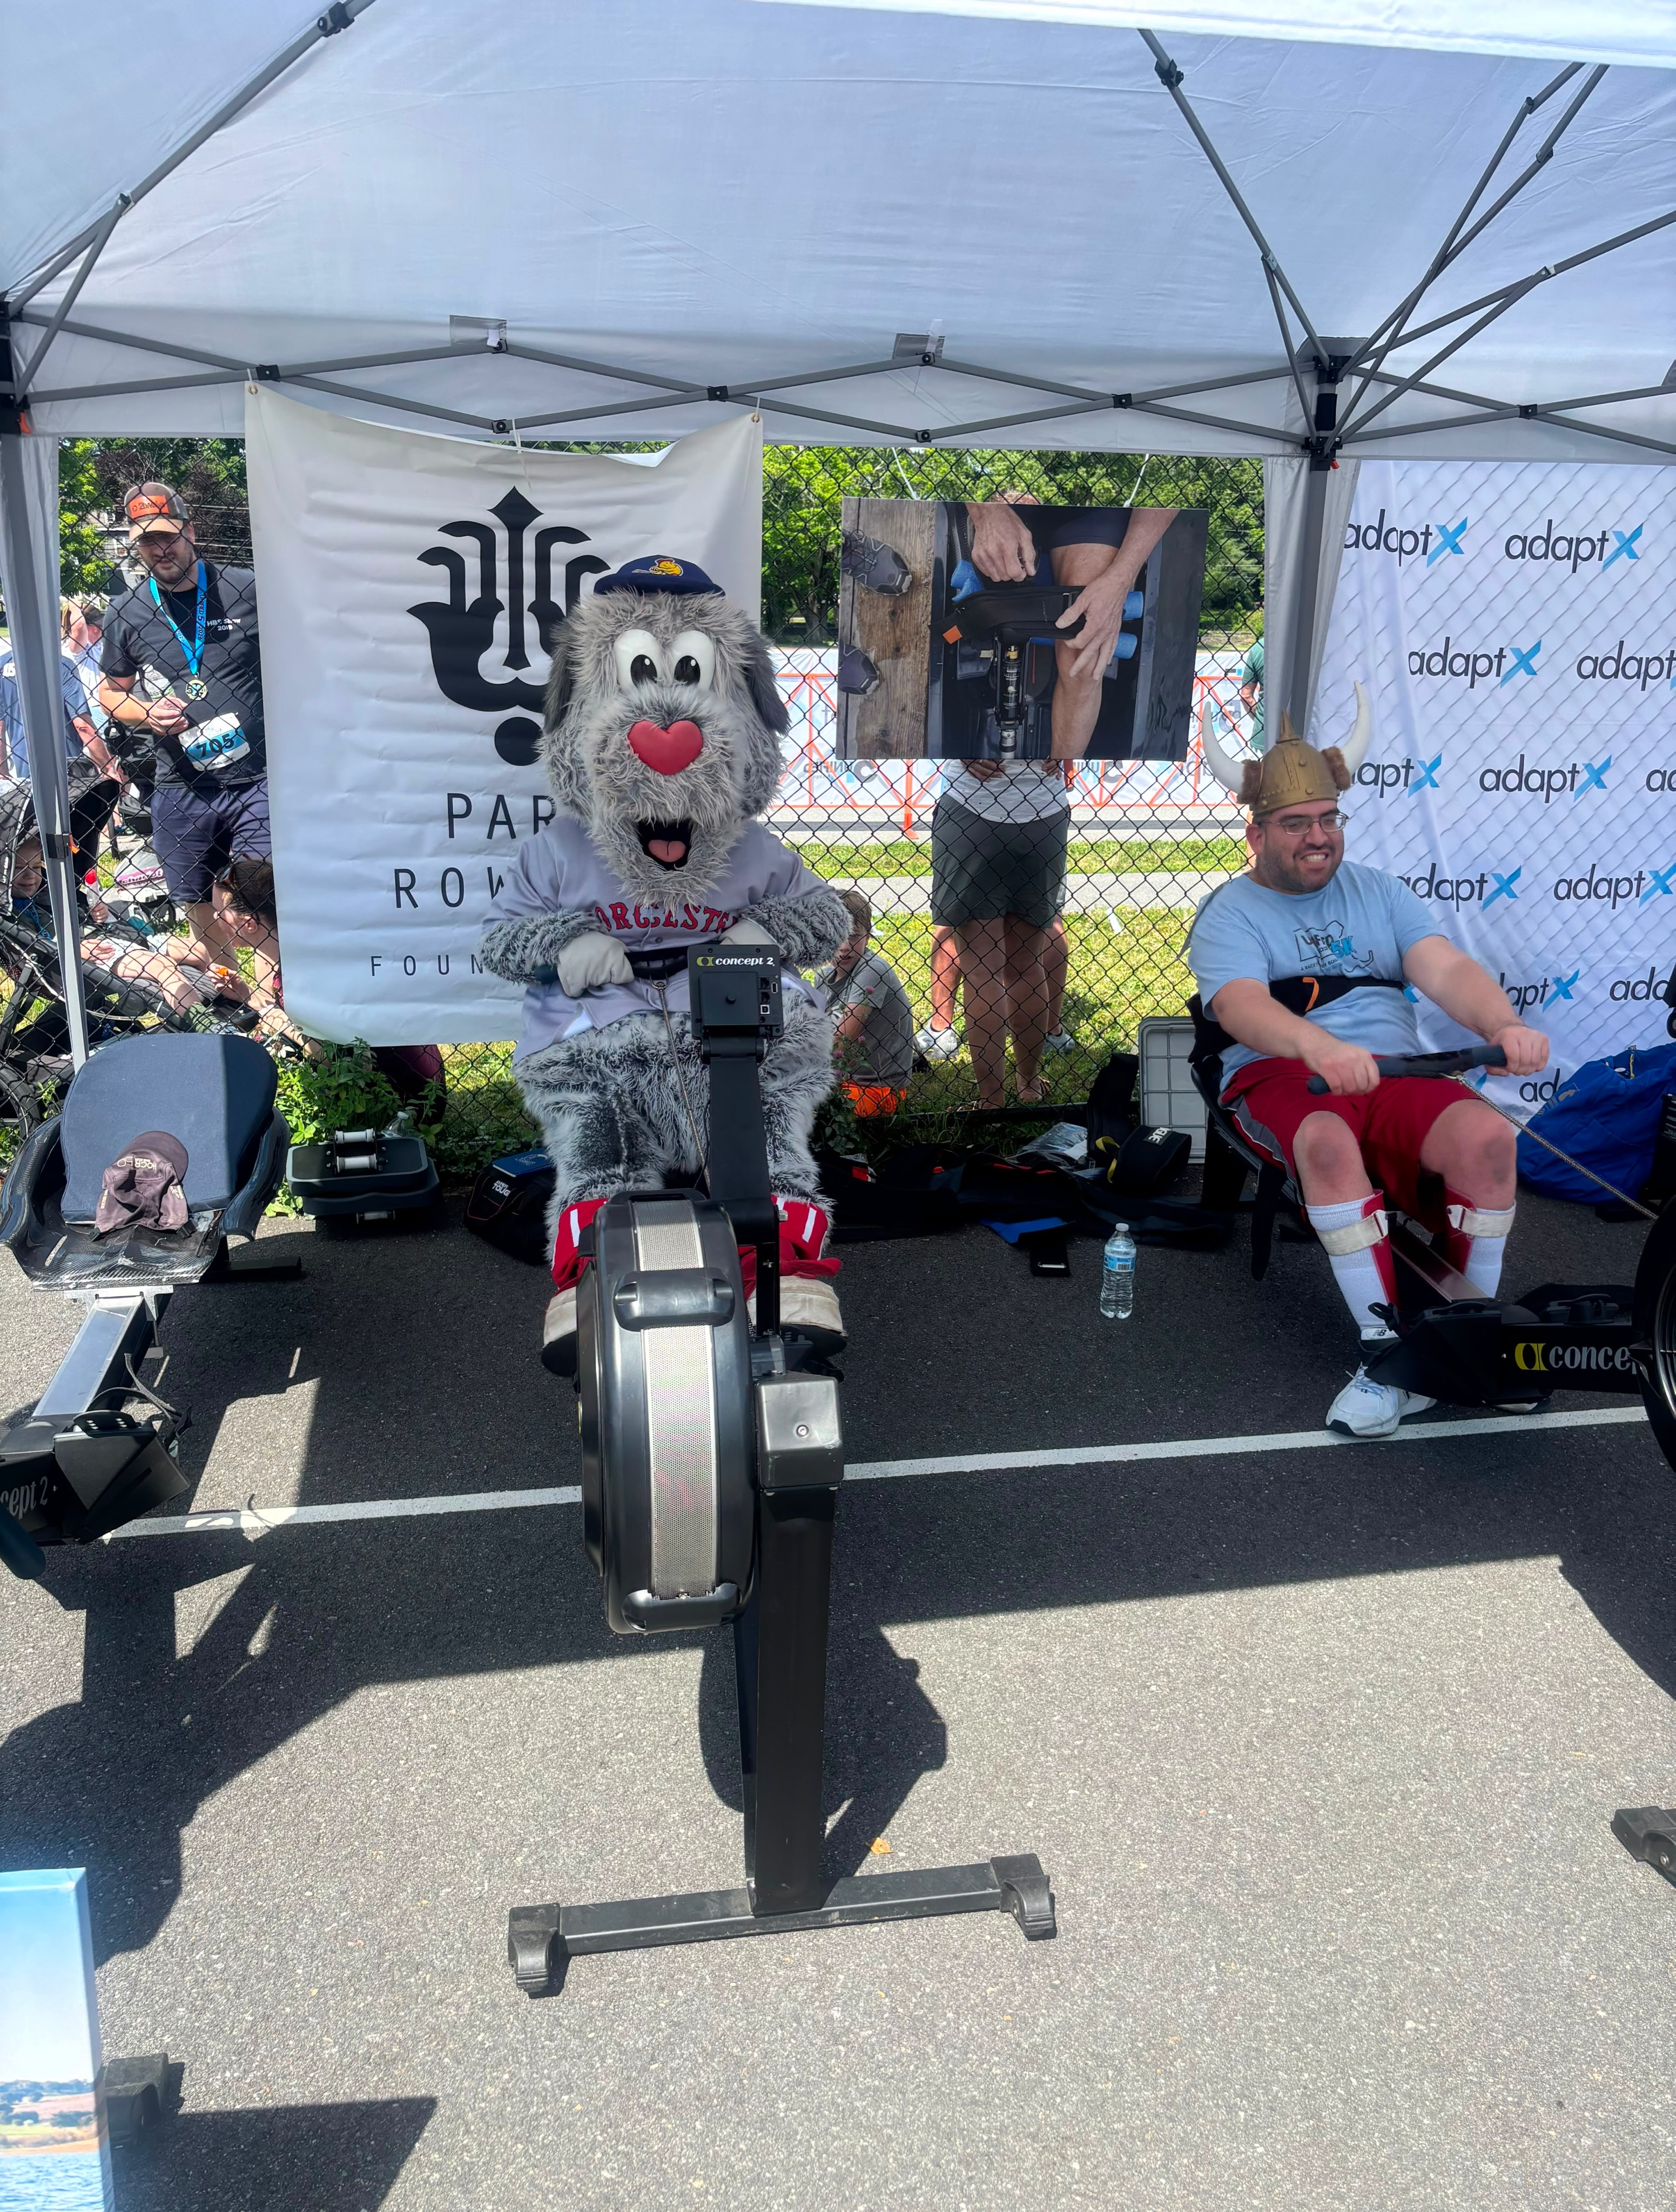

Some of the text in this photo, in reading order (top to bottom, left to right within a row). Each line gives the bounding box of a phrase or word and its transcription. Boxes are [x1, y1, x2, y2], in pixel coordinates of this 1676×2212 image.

[1505, 519, 1643, 573] adaptX
[1408, 637, 1542, 689] adaptX
[1577, 640, 1676, 692] adapt
[196, 733, 234, 758] 705
[1351, 752, 1442, 799] aptX
[1479, 754, 1612, 803] adaptX
[1554, 864, 1676, 910] adaptX
[595, 902, 738, 934] ORCESTE
[716, 957, 775, 966] concept 2
[1331, 936, 1357, 959] 5K
[1500, 968, 1580, 1015] aptX
[1148, 1127, 1172, 1144] GUE
[40, 1476, 48, 1506] 2
